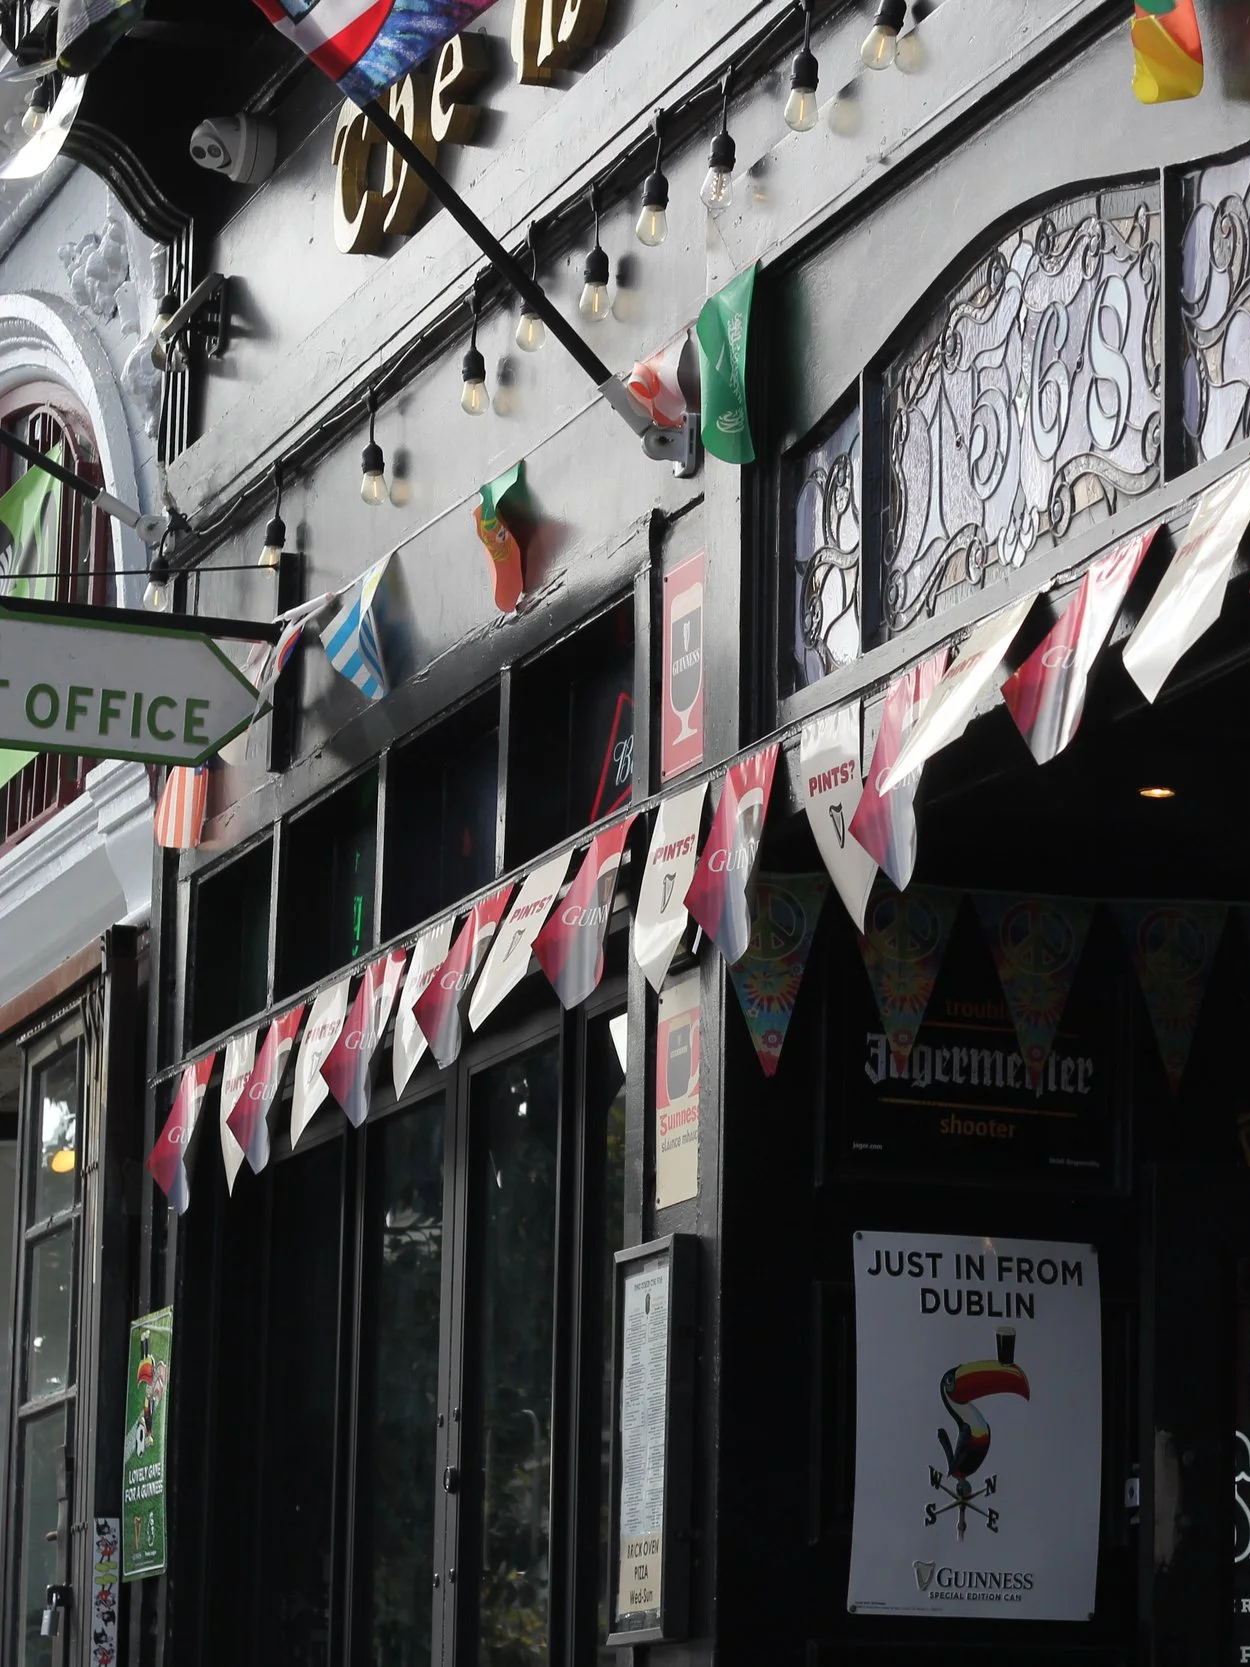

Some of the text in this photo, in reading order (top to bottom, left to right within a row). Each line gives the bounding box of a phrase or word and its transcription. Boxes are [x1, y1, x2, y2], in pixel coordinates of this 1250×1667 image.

[913, 272, 1133, 560] 1568
[25, 682, 211, 745] OFFICE
[808, 759, 856, 798] PINTS?
[652, 833, 696, 866] PINTS?
[509, 893, 554, 924] PINTS?
[943, 996, 1013, 1020] troubl
[864, 1031, 1096, 1099] Jgermeter
[939, 1112, 1018, 1140] shooter
[867, 1250, 1083, 1287] JUST IN FROM
[920, 1287, 1035, 1319] DUBLIN
[129, 1466, 148, 1485] LOVELY
[928, 1465, 943, 1490] W
[984, 1475, 998, 1497] N
[924, 1503, 938, 1527] S
[986, 1508, 999, 1534] E
[626, 1538, 660, 1559] BRICK OVEN
[634, 1564, 649, 1581] PIZZA
[936, 1567, 1034, 1590] GUINNESS
[929, 1591, 1023, 1603] SPECIAL EDITION CAN
